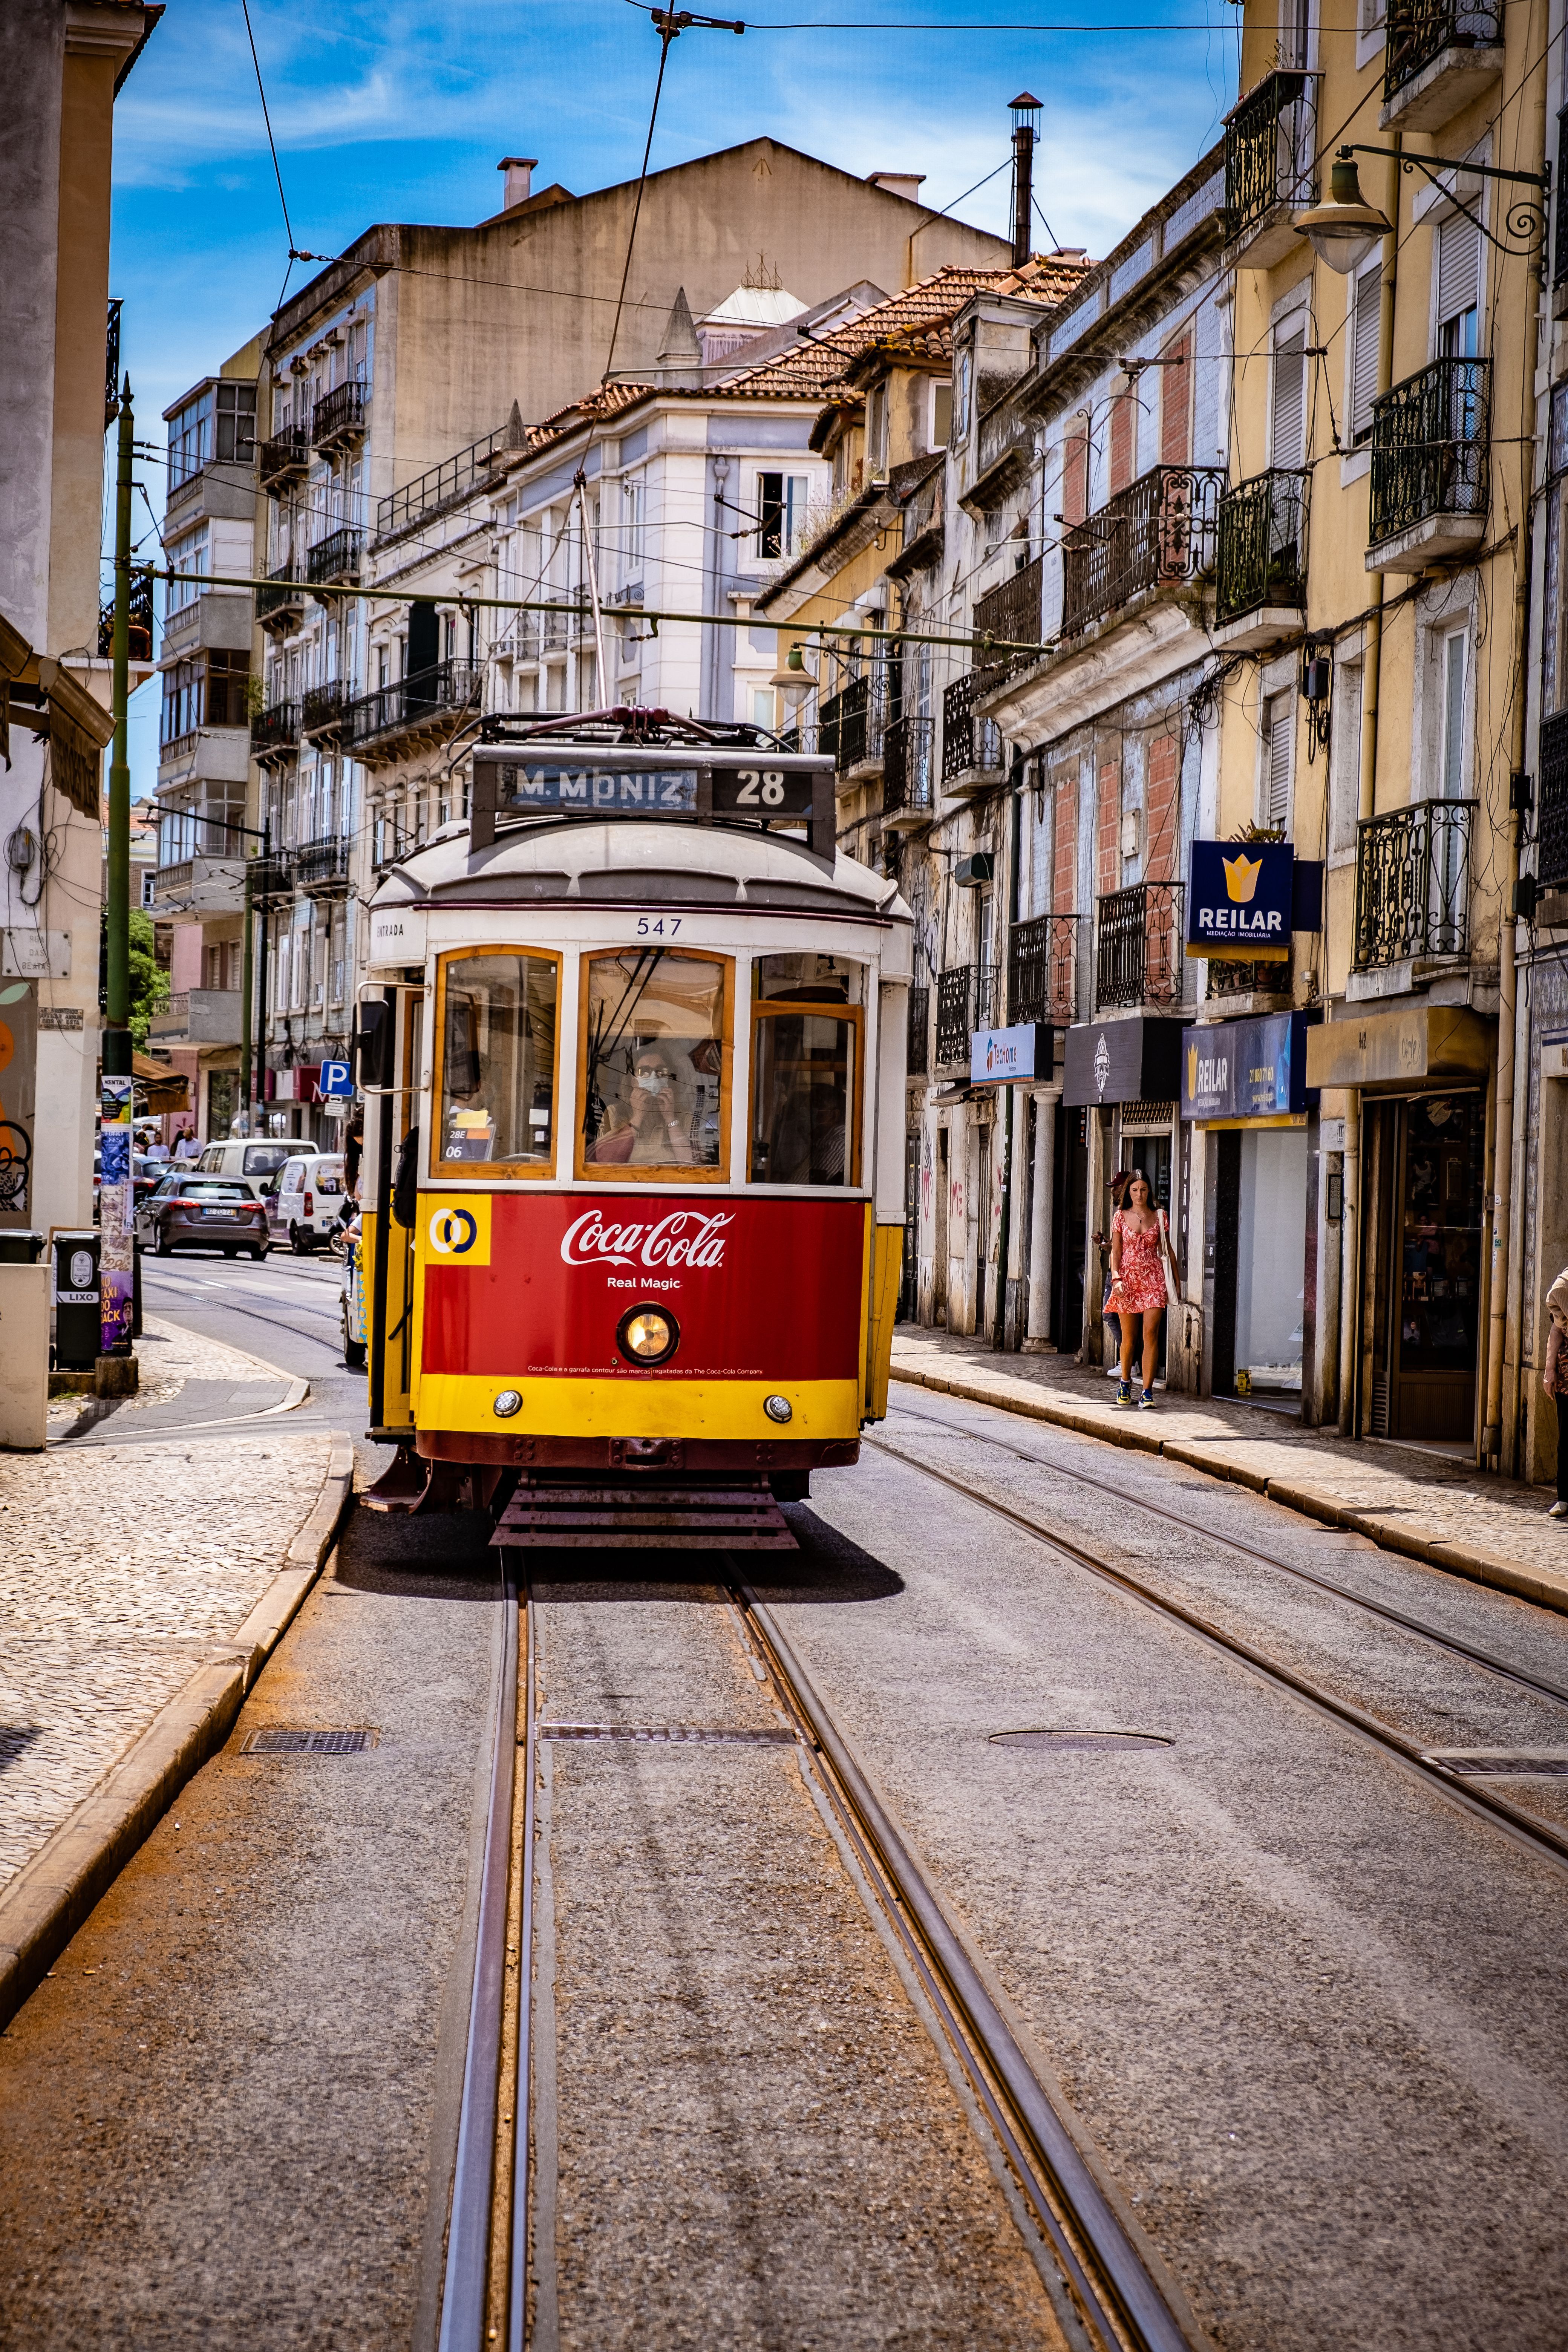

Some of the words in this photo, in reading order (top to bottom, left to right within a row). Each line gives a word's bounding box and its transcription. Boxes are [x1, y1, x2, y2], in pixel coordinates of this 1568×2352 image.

[517, 768, 551, 796] M.
[559, 768, 684, 801] MONIZ
[737, 770, 785, 804] 28
[637, 917, 682, 936] 547
[1199, 908, 1282, 931] REILAR
[377, 924, 404, 937] ENTRADA
[994, 1043, 1017, 1064] TecHome
[1198, 1057, 1227, 1093] REILAR
[1249, 1069, 1255, 1083] 21
[1268, 1066, 1274, 1081] 60
[450, 1130, 466, 1139] 28E
[446, 1146, 462, 1158] 06
[560, 1210, 736, 1267] Coca-Cola
[607, 1277, 637, 1288] Real
[641, 1277, 681, 1291] Magic
